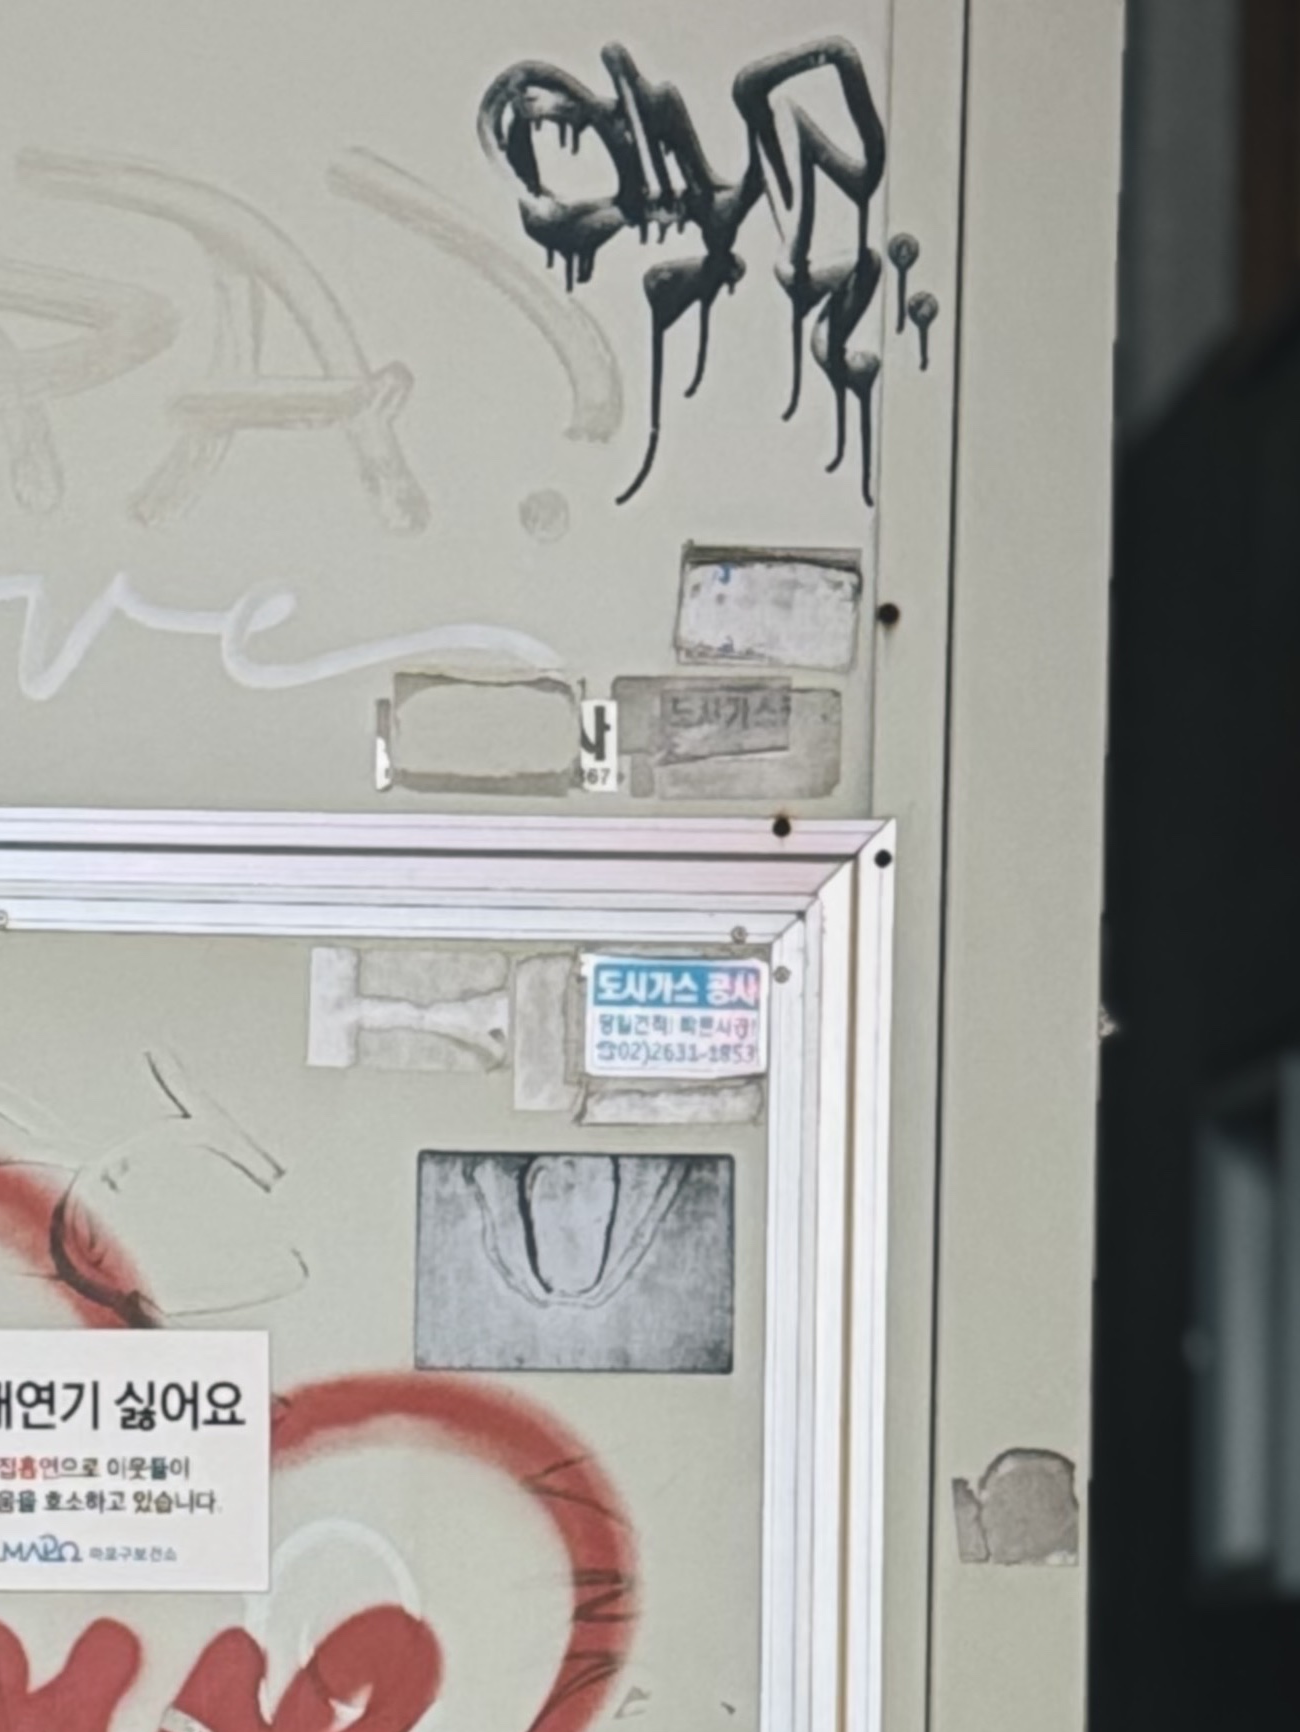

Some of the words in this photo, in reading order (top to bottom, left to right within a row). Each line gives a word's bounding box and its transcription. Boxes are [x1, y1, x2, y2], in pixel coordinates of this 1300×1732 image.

[597, 969, 699, 1004] 도시가스
[706, 970, 760, 1006] 공사
[114, 1380, 247, 1431] 싫어요
[107, 1456, 191, 1481] 이웃들이
[44, 1488, 127, 1514] 호소하고
